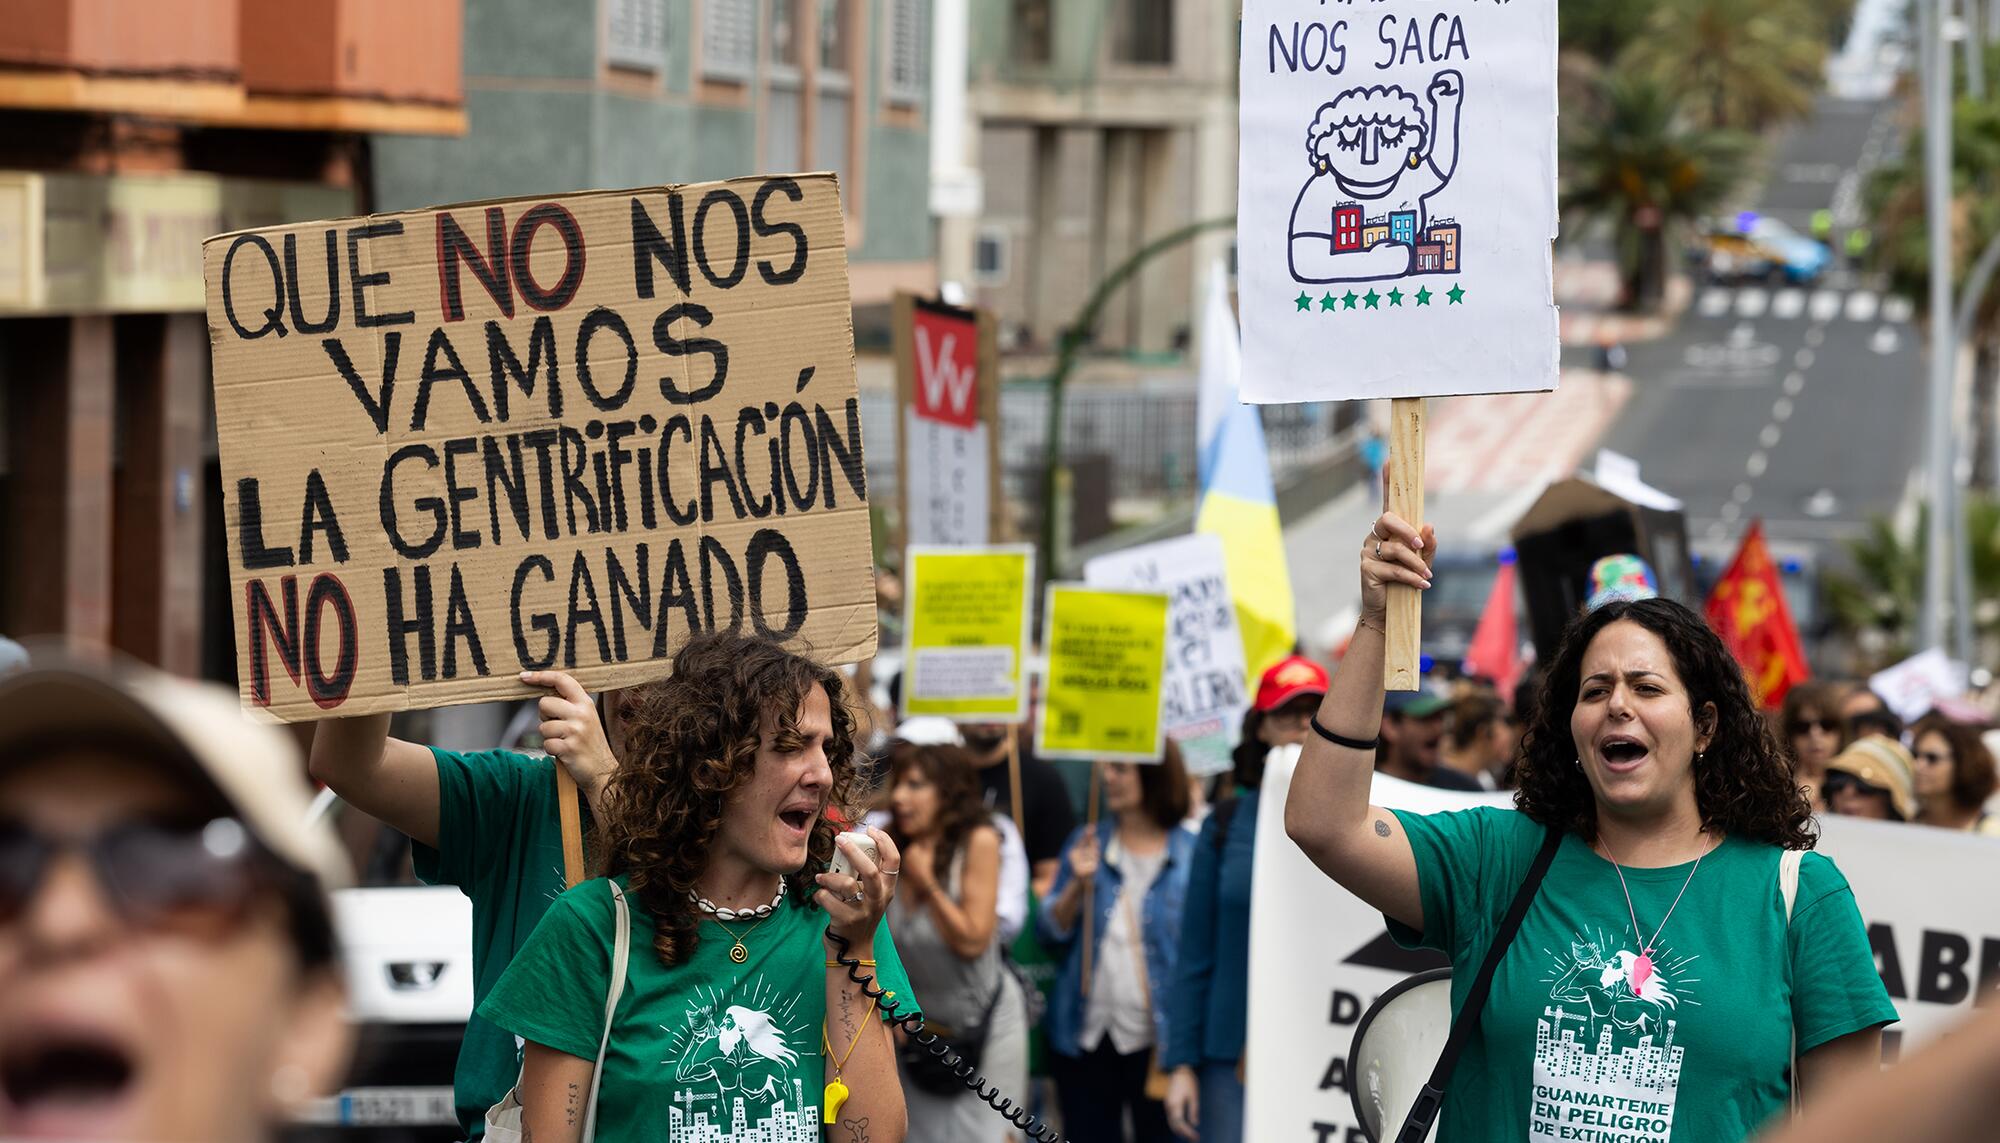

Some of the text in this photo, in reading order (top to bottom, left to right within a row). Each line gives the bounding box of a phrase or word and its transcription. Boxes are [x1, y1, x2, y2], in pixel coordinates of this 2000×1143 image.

[1268, 12, 1470, 75] NOS SACA
[222, 221, 415, 339] QUE
[434, 202, 587, 322] NO
[632, 178, 809, 298] NOS
[322, 303, 730, 434] VAMOS
[237, 468, 350, 569] LA
[245, 527, 809, 710] NO HA GANADO
[1533, 1120, 1554, 1137] DE
[1534, 1101, 1668, 1134] EN PELIGRO
[1536, 1085, 1670, 1116] GUANARTEME
